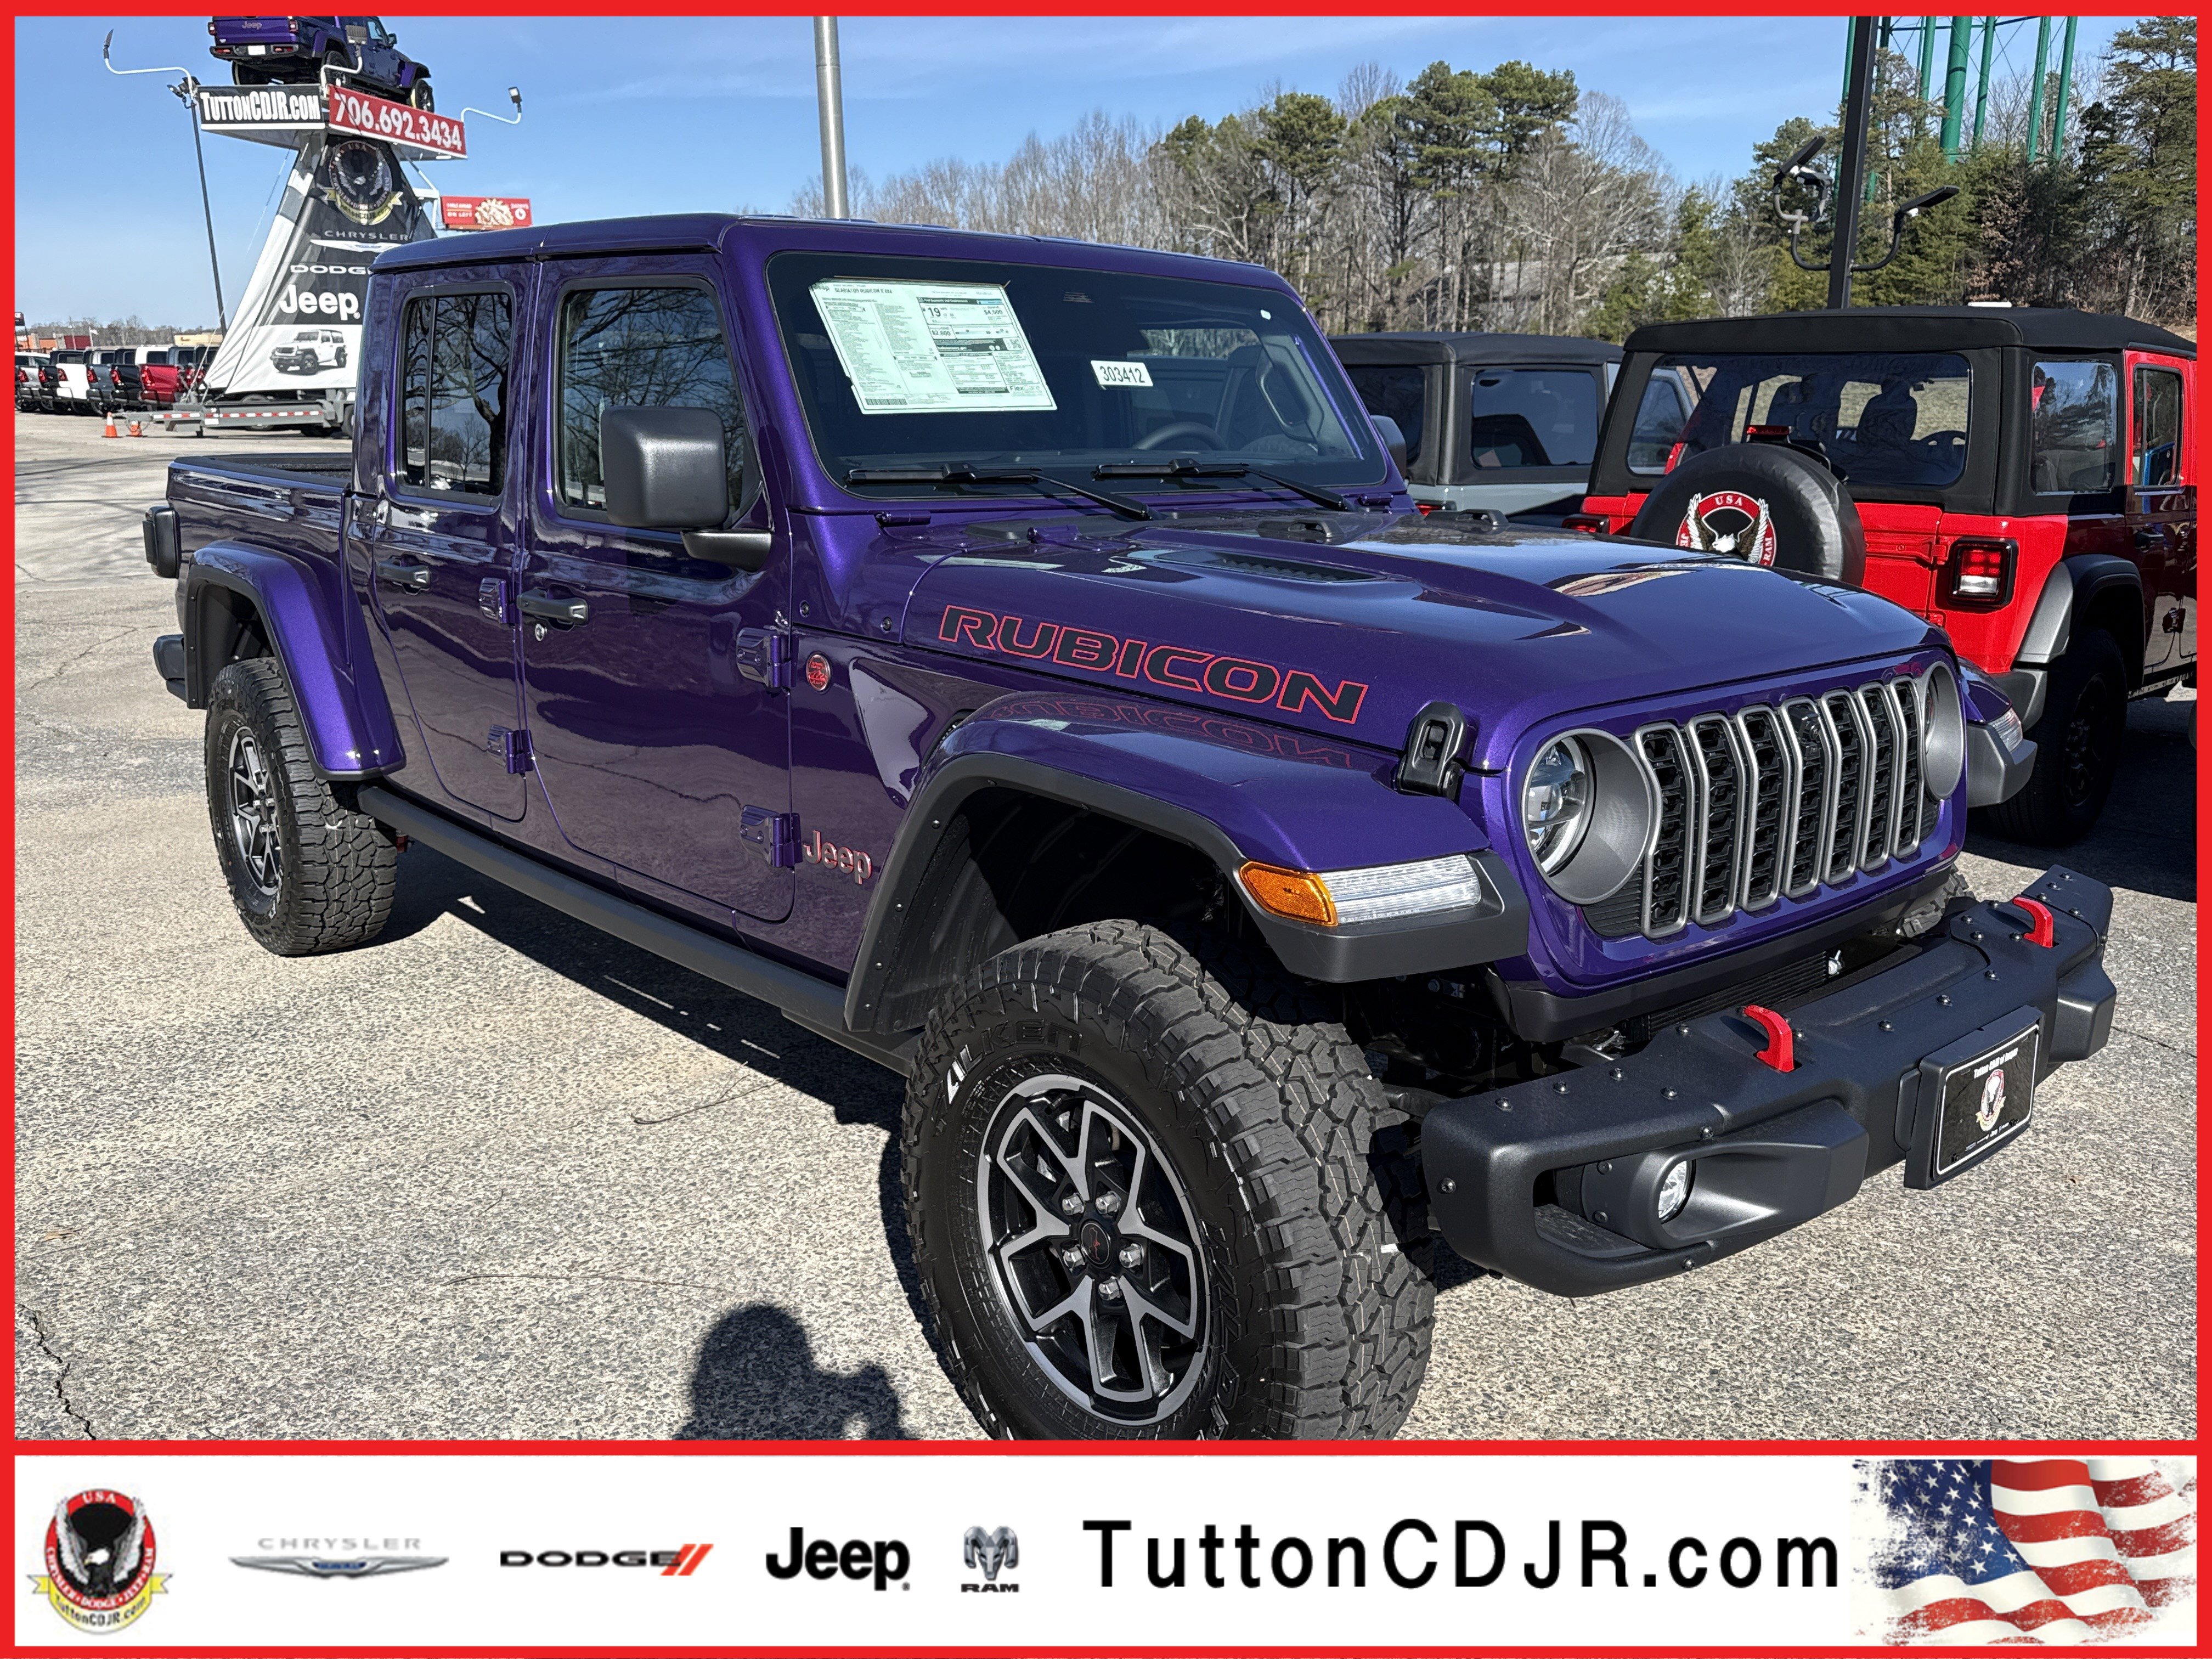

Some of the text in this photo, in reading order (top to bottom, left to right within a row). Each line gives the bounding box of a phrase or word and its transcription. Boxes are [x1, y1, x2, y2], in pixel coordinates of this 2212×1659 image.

[242, 21, 262, 30] Jeep
[334, 92, 461, 150] 706.692.3434
[324, 230, 409, 241] CHRYSLER
[279, 284, 359, 321] Jeep
[928, 307, 941, 317] 19
[1099, 366, 1146, 383] 303412
[1714, 495, 1742, 506] USA
[1763, 537, 1773, 562] RAM
[938, 605, 1369, 725] RUBICON
[803, 830, 873, 885] Jeep
